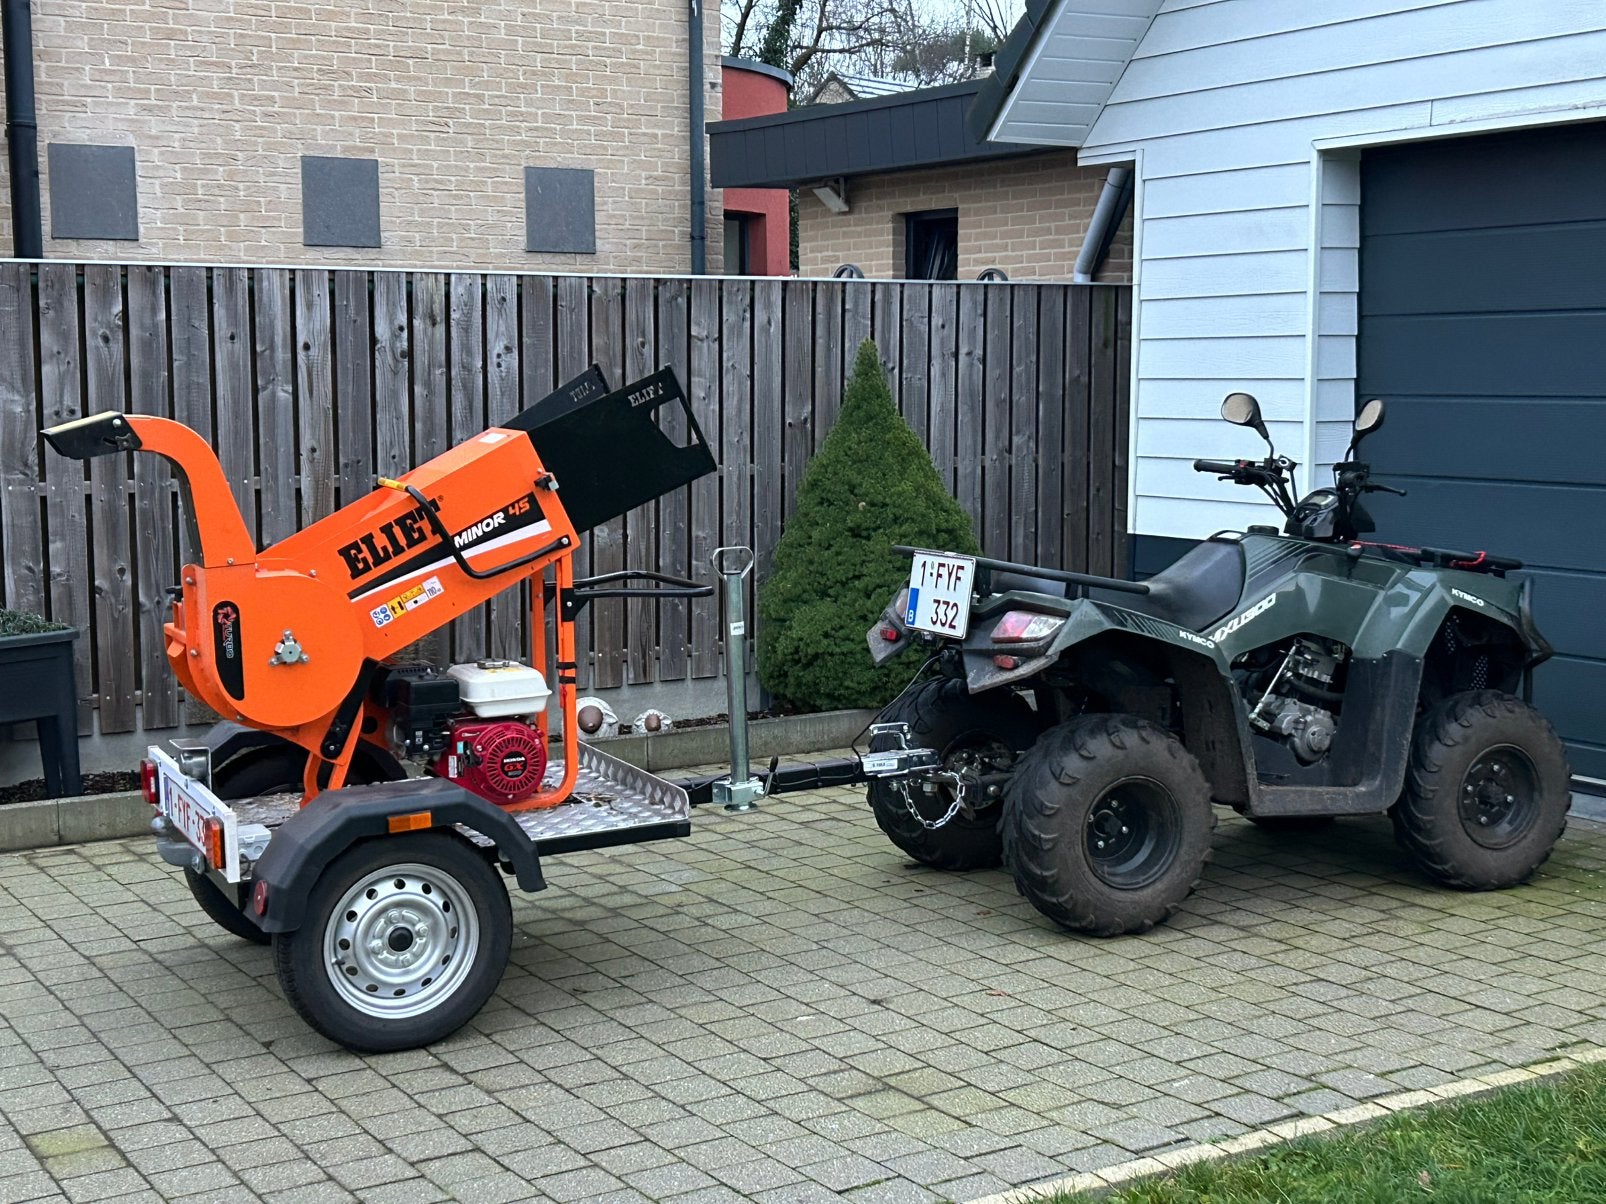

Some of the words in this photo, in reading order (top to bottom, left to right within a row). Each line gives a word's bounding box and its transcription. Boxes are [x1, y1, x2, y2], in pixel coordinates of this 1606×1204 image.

[453, 511, 506, 548] MINOR
[508, 497, 530, 516] 45
[337, 498, 442, 580] ELIET
[1451, 588, 1485, 607] KYMCO
[908, 610, 914, 622] B
[930, 599, 959, 630] 332
[1179, 630, 1215, 649] KYMCO
